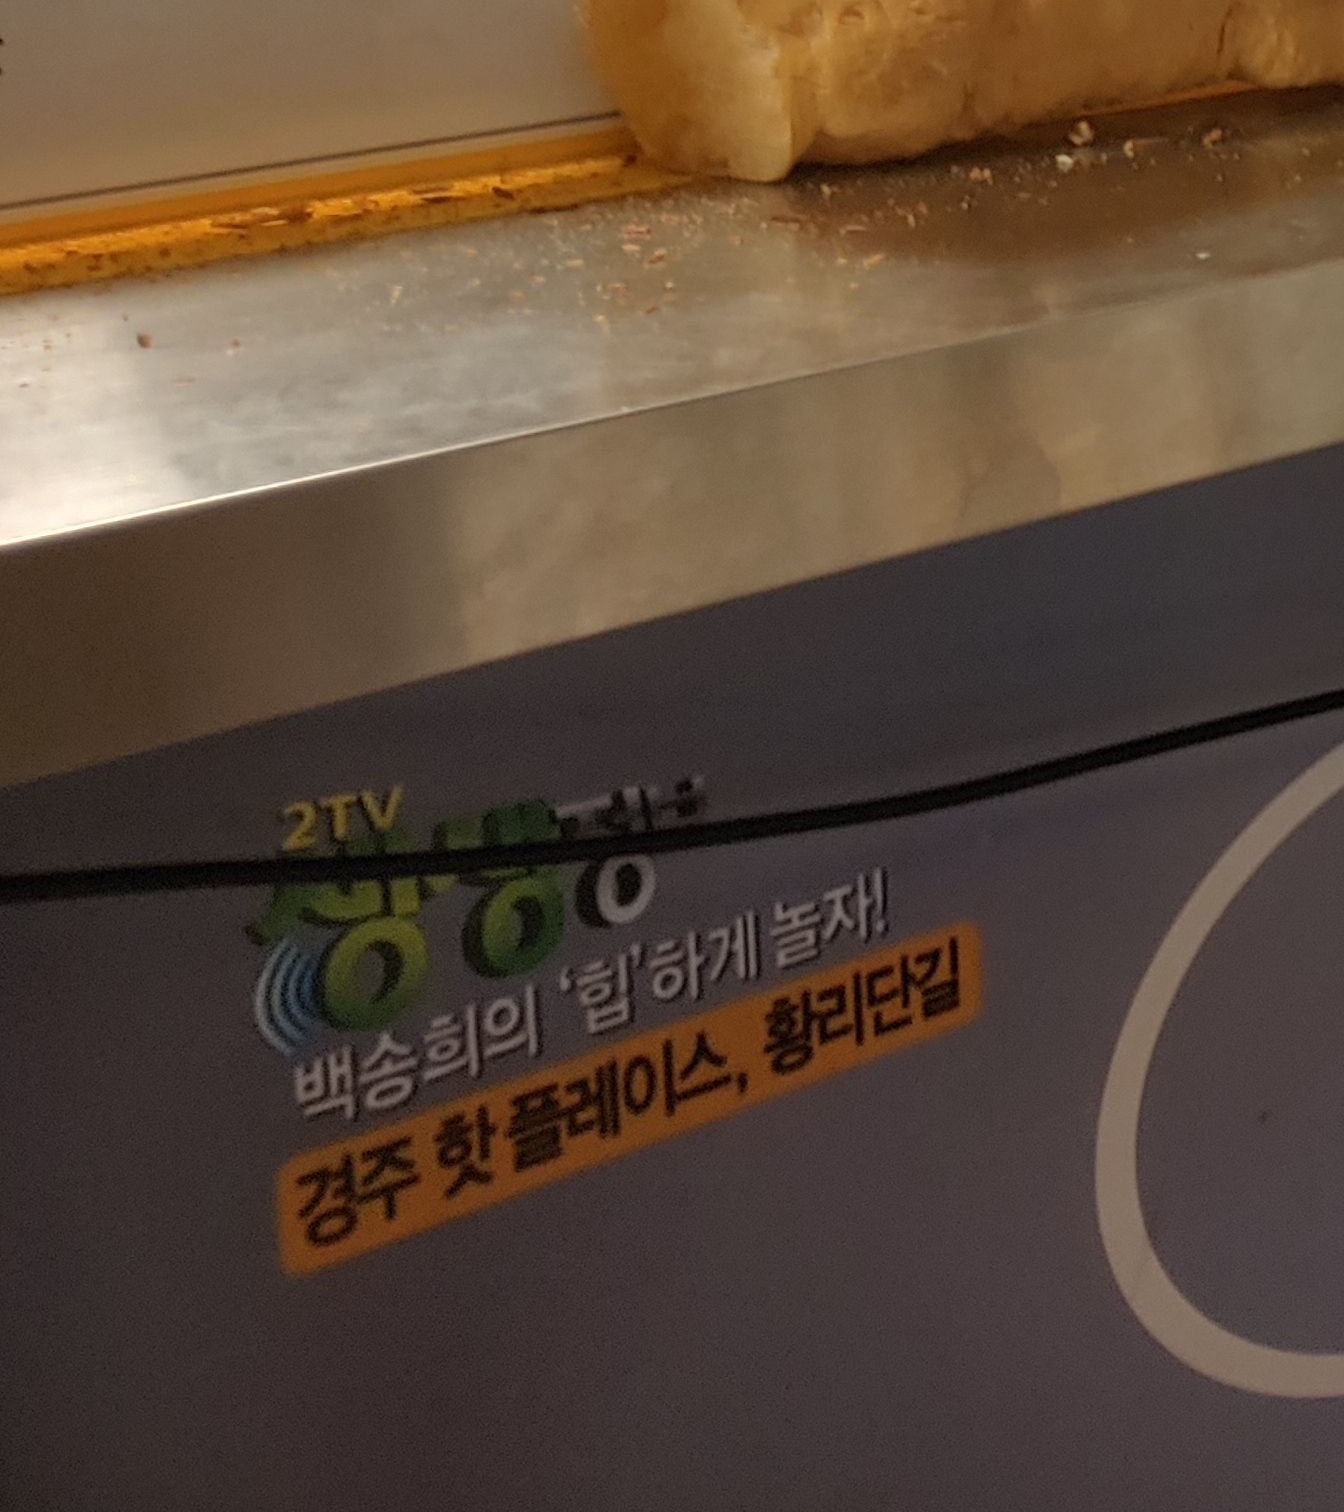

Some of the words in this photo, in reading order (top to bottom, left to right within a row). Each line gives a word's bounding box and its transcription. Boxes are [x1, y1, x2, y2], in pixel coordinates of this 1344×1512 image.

[280, 783, 406, 851] 2TV
[294, 982, 540, 1122] 백송희의
[769, 866, 889, 971] 놀자!
[295, 1138, 421, 1250] 경주
[434, 1102, 494, 1200] 핫
[508, 1029, 751, 1174] 플레이스,
[764, 936, 963, 1078] 황리단길
